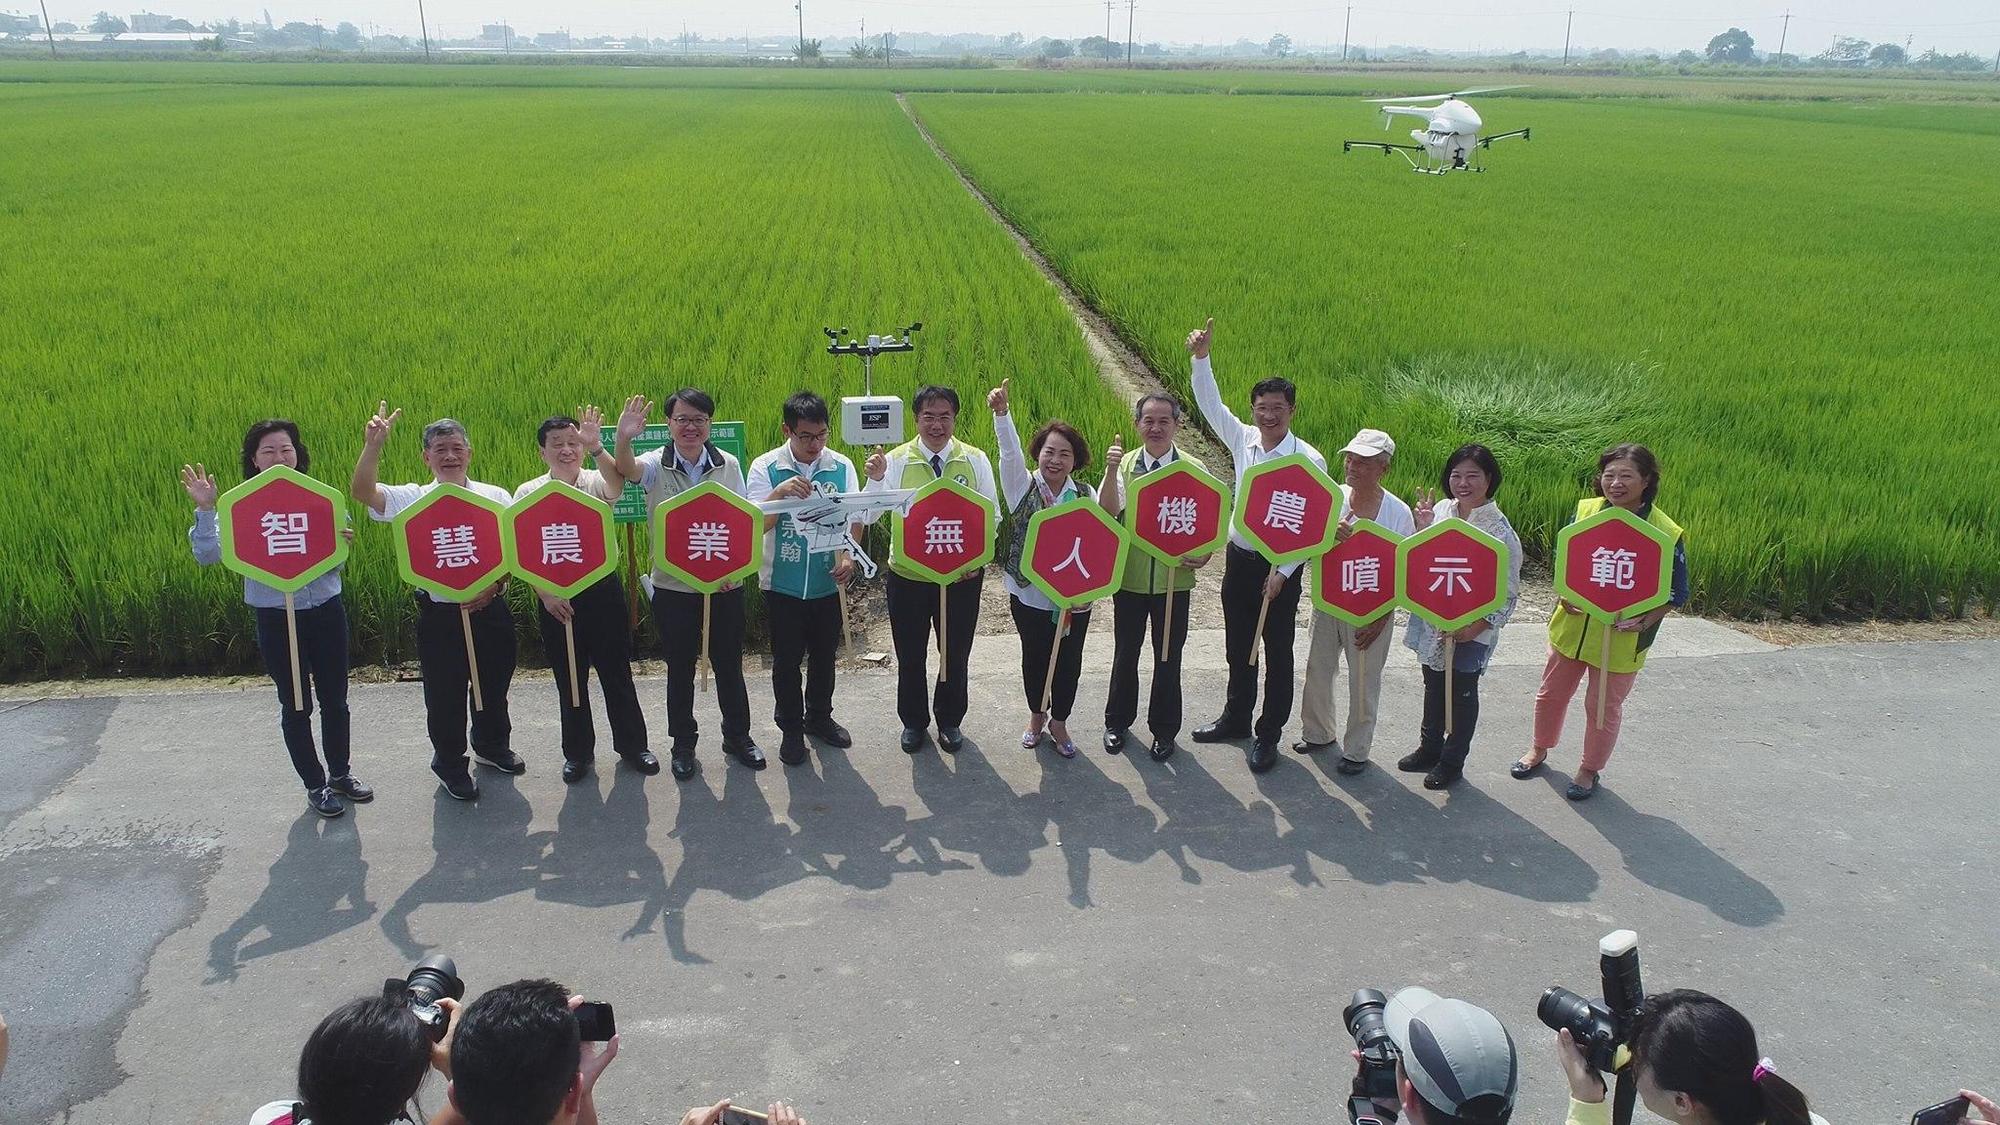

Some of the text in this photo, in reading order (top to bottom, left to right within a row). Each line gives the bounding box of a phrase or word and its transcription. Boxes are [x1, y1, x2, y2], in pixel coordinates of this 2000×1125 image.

[1157, 497, 1197, 535] 機
[1263, 491, 1305, 534] 農
[261, 512, 308, 556] 智
[432, 525, 479, 568] 慧
[541, 523, 583, 564] 農
[688, 523, 730, 561] 業
[781, 519, 801, 562] 宗翰
[925, 516, 963, 554] 無
[1052, 537, 1090, 580] 人
[1342, 556, 1380, 594] 噴
[1429, 557, 1472, 596] 示
[1590, 547, 1637, 589] 範
